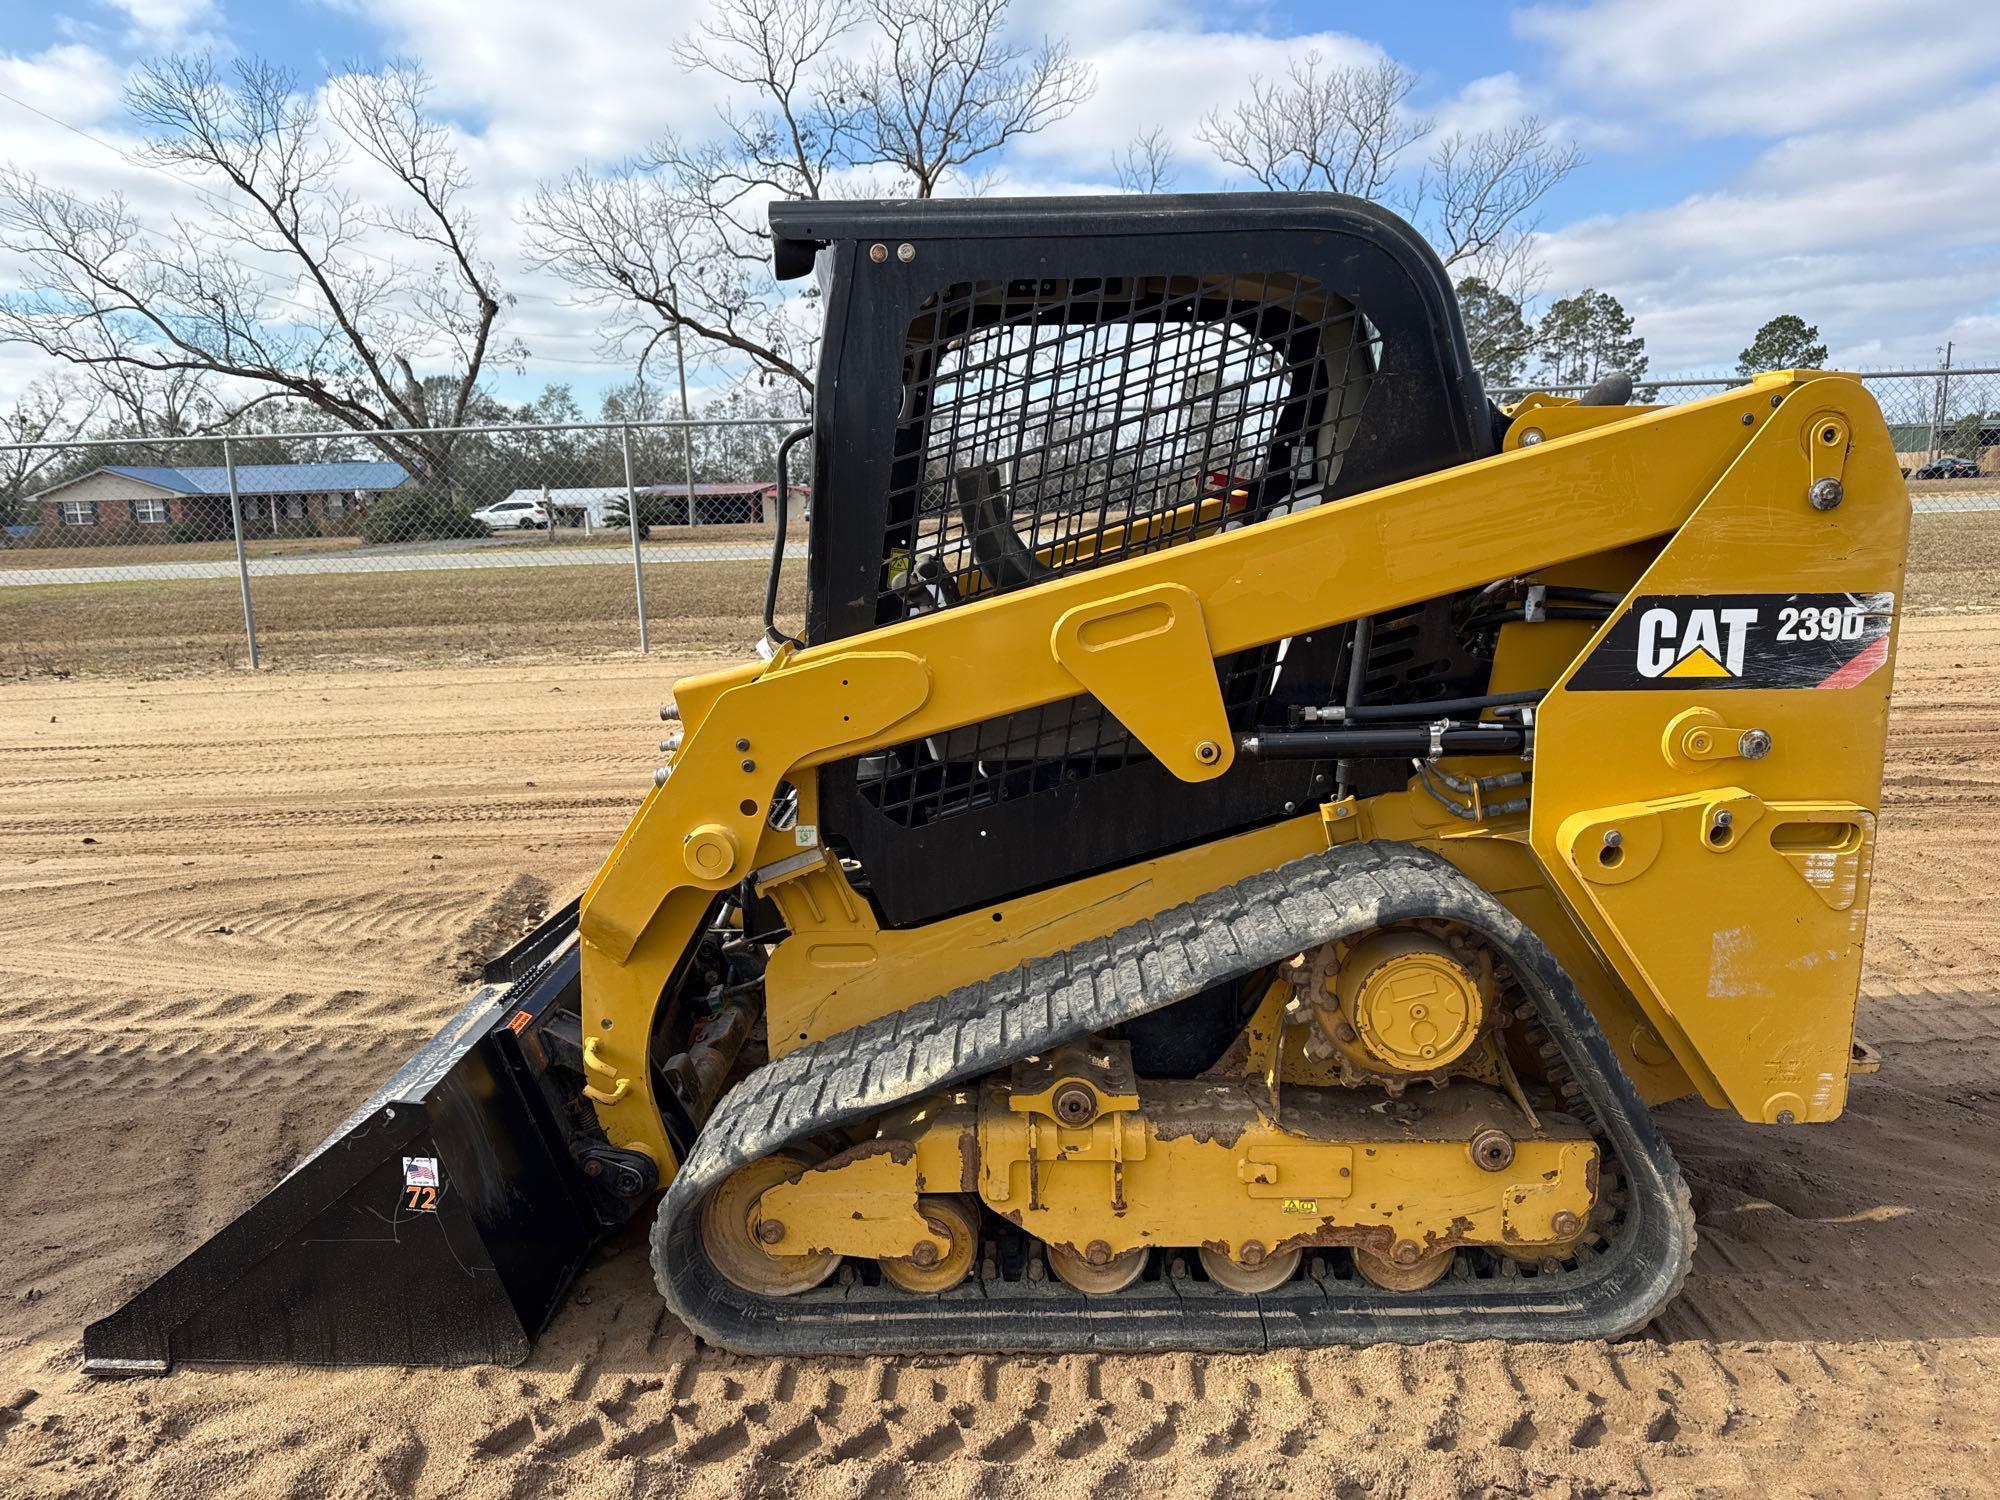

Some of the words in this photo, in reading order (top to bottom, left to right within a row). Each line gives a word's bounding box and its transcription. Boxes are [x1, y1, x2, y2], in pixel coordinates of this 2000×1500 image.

[1637, 608, 1758, 678] CAT
[1776, 606, 1865, 641] 239D
[406, 1186, 437, 1209] 72
